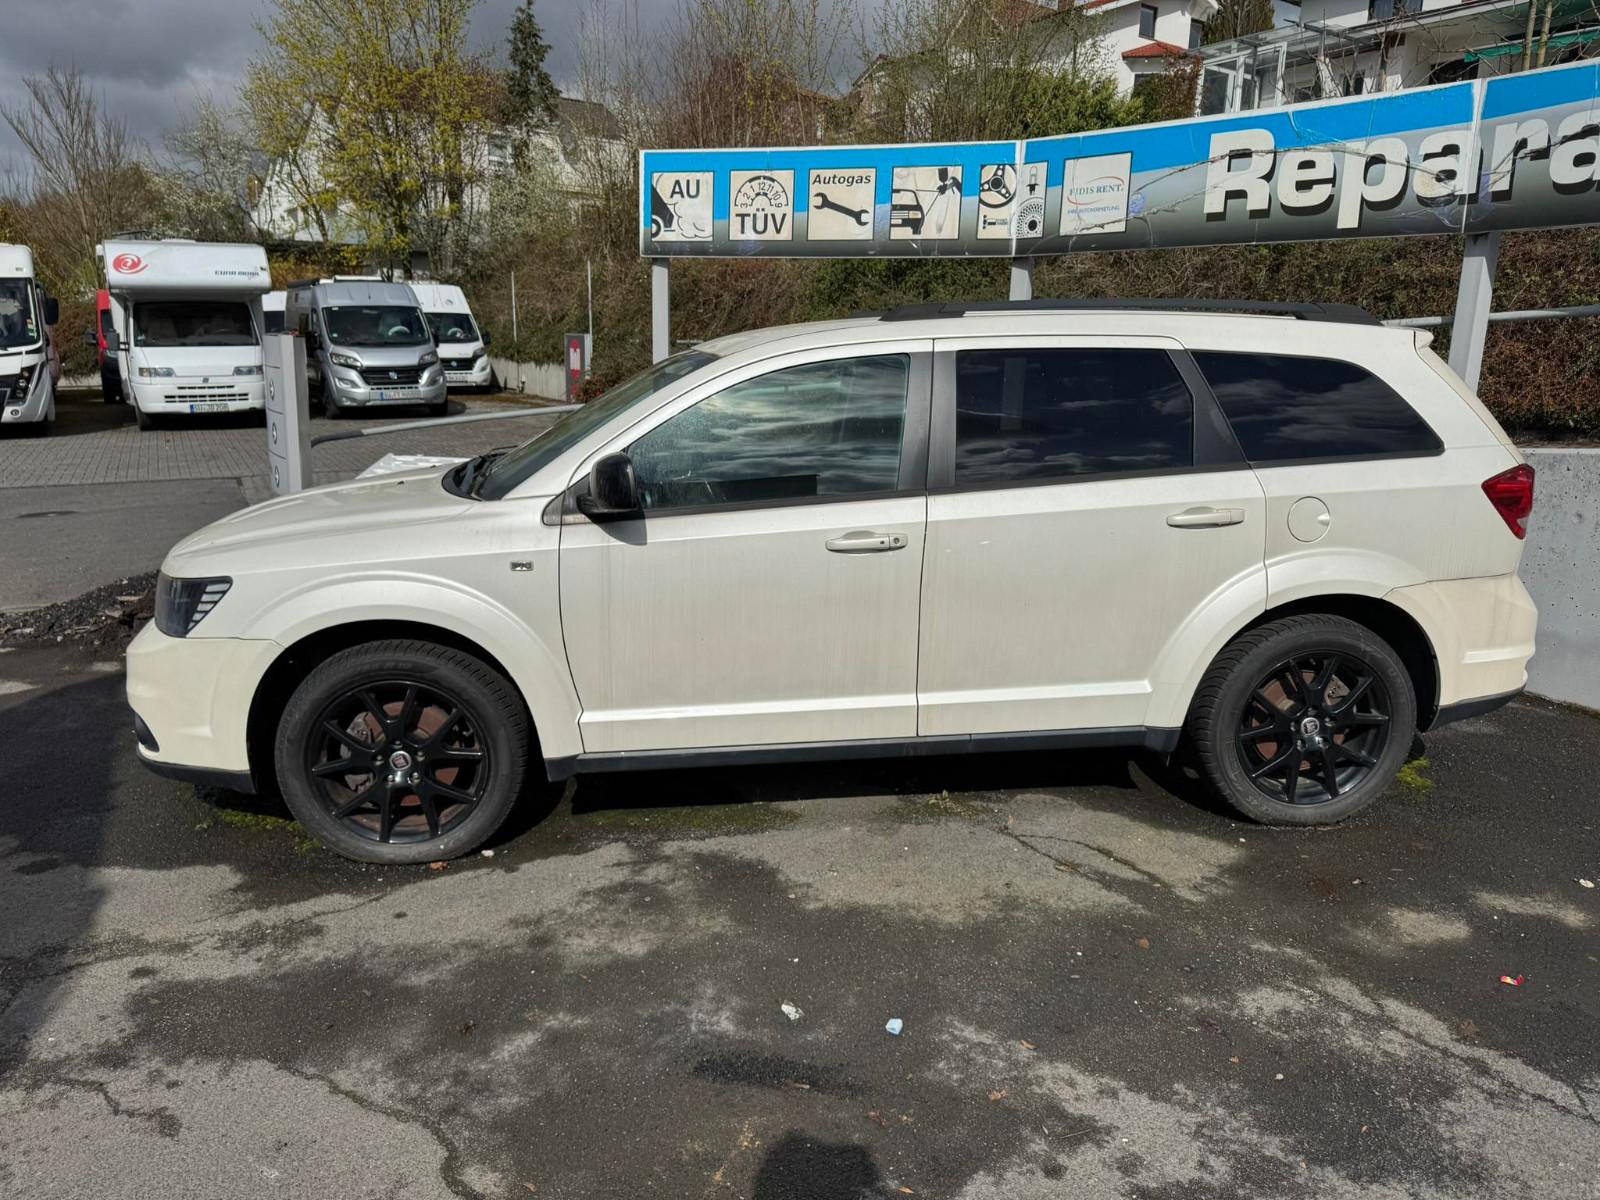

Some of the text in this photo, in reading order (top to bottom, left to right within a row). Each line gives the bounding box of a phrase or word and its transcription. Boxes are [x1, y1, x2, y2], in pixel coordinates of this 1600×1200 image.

[1204, 111, 1600, 229] Repara
[670, 179, 701, 199] AU
[812, 173, 872, 187] Autogas
[1096, 183, 1122, 194] RENT
[758, 182, 766, 191] 12
[767, 184, 774, 193] 11
[772, 191, 781, 201] 10
[735, 208, 787, 235] TÜV
